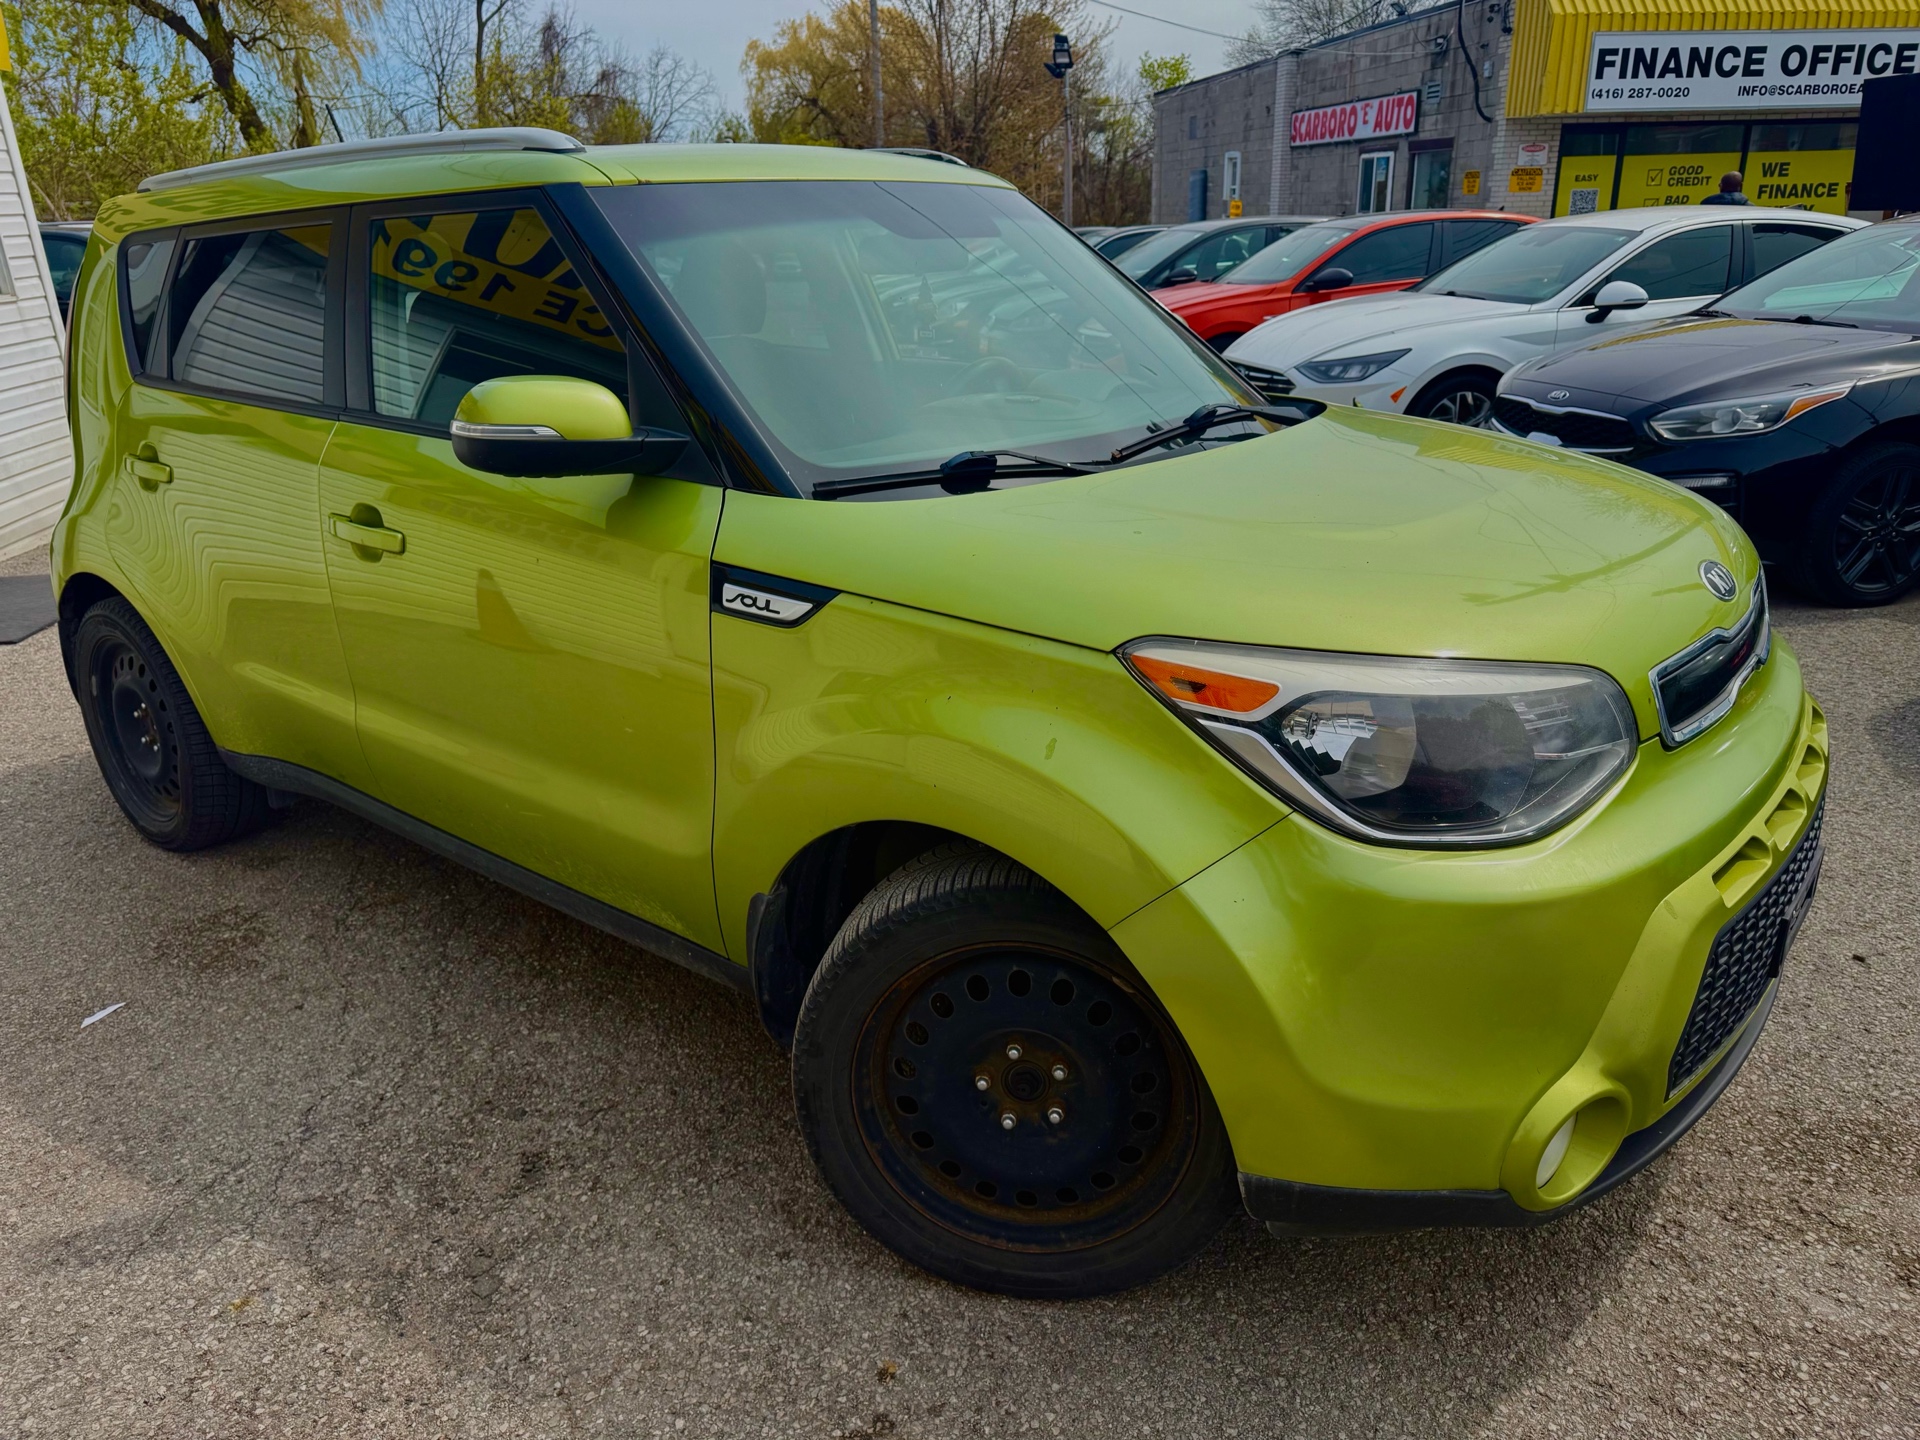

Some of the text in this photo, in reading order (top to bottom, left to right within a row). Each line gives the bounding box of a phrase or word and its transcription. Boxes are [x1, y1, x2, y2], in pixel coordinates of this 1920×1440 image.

[1595, 43, 1919, 80] FINANCE OFFICE
[1591, 87, 1690, 99] (416) 287-0020
[1291, 104, 1358, 144] SCARBORO
[1373, 94, 1415, 133] AUTO
[1669, 165, 1704, 176] GOOD
[1761, 162, 1791, 178] WE
[1574, 174, 1599, 182] EASY
[1667, 176, 1712, 187] CREDIT
[1757, 182, 1839, 200] FINANCE
[1664, 195, 1690, 205] BAD
